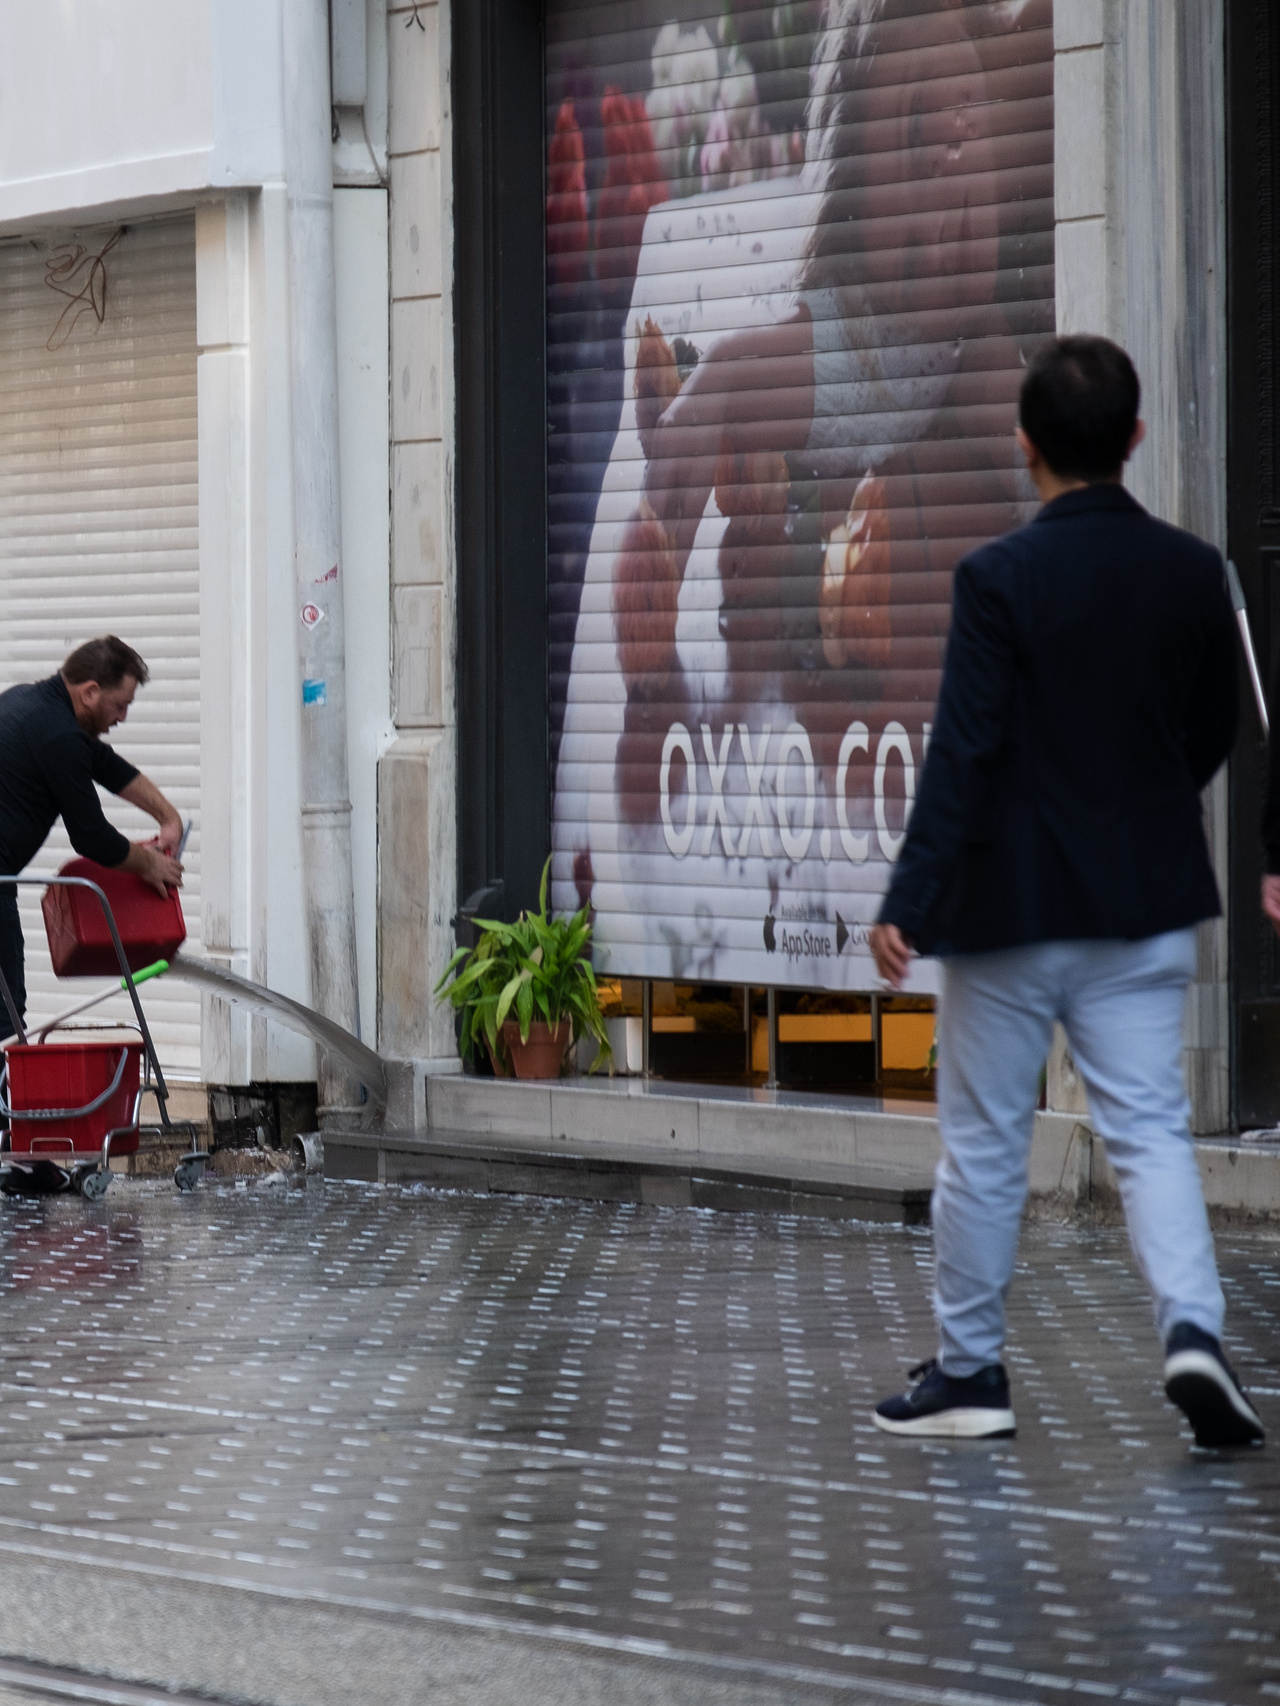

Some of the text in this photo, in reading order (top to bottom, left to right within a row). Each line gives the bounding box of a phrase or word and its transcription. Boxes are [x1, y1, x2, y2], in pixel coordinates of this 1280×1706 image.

[660, 721, 932, 864] OXXO.CO
[781, 927, 831, 962] App Store
